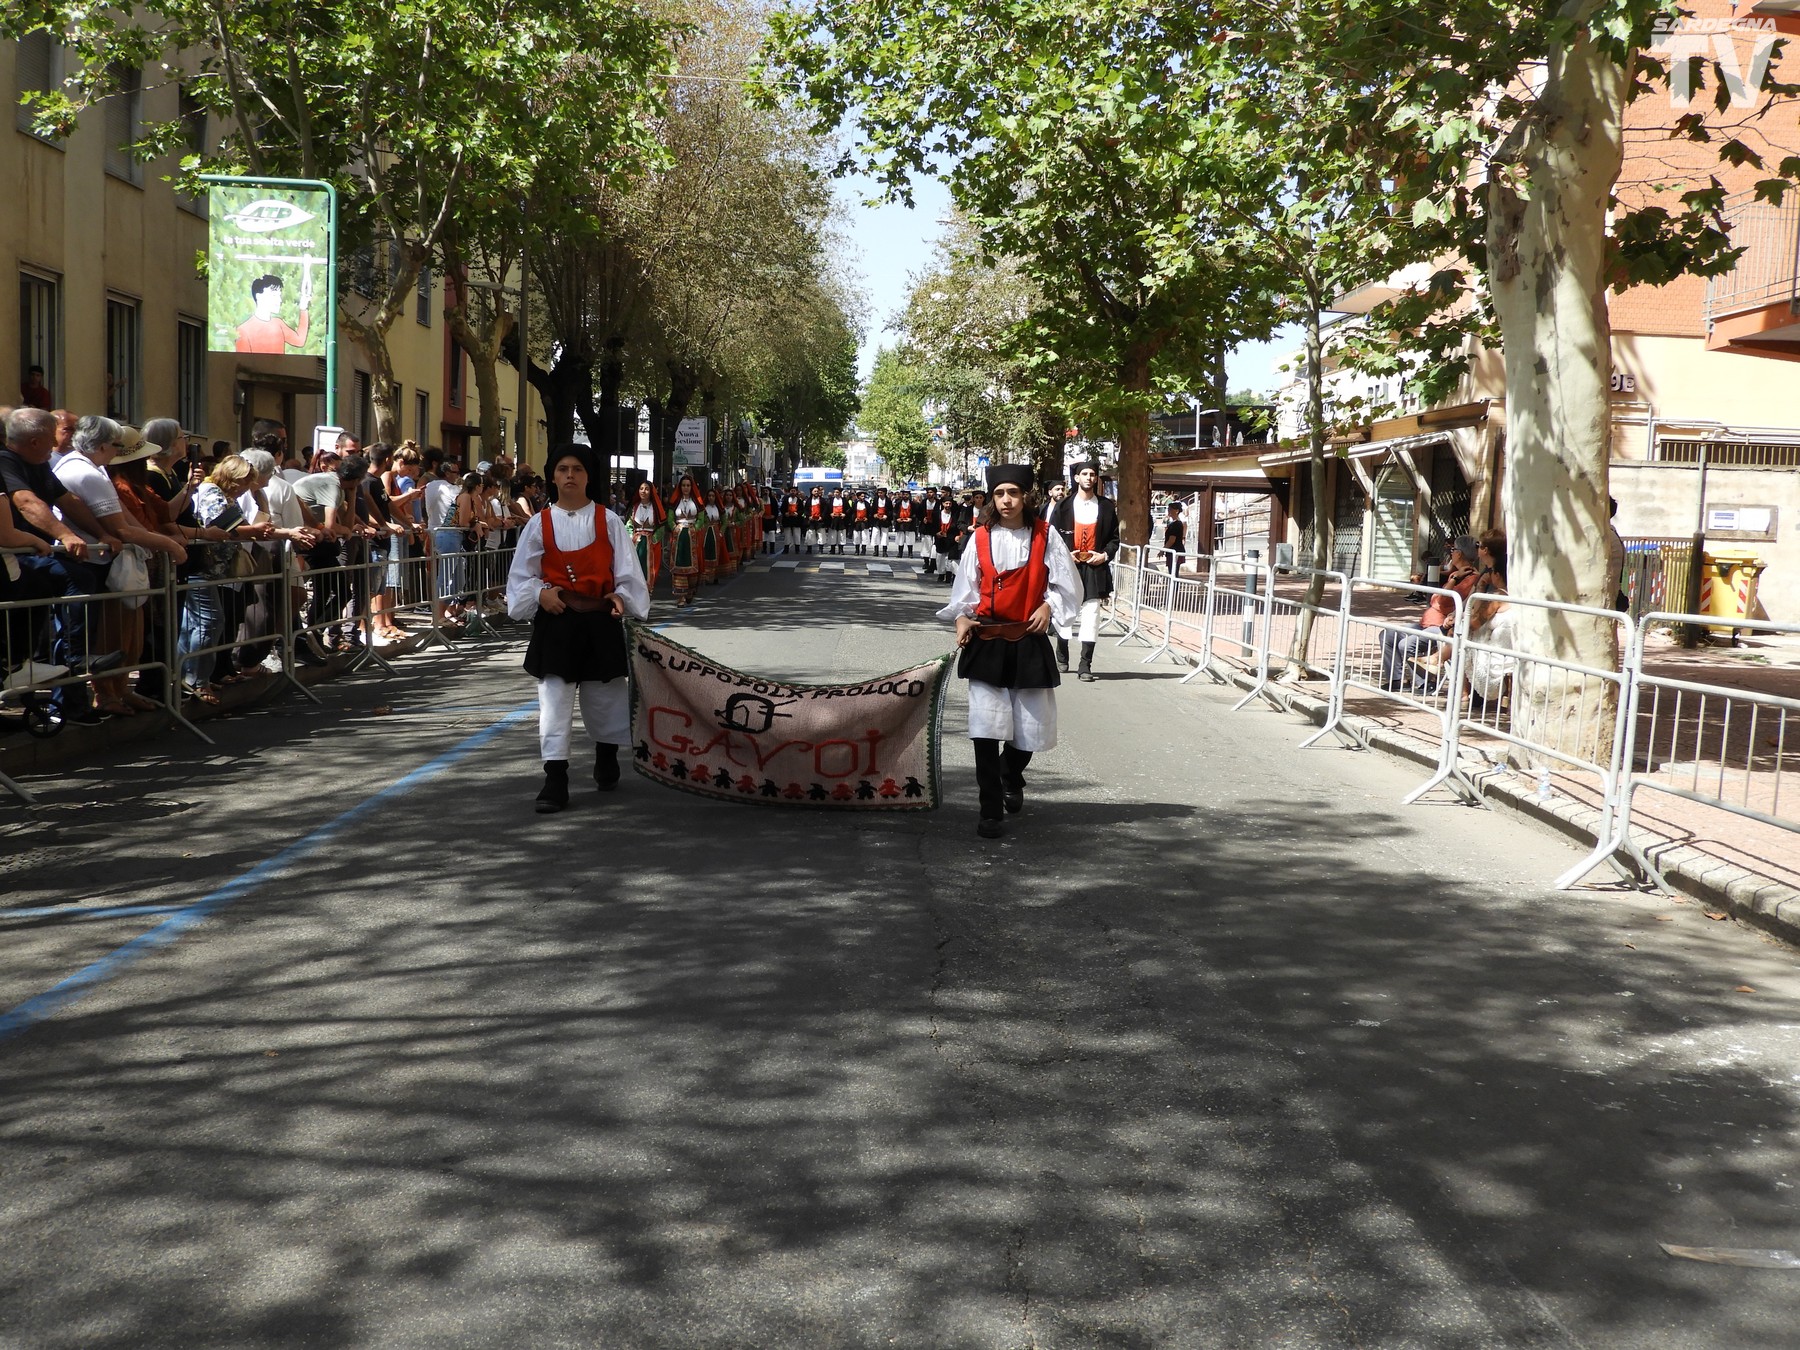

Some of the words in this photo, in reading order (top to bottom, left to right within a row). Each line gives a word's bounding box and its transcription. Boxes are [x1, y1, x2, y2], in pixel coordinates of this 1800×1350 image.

[241, 206, 292, 222] ATP
[224, 235, 233, 244] la
[234, 235, 252, 245] tua
[286, 238, 316, 248] verde
[638, 644, 732, 683] GRUPPO
